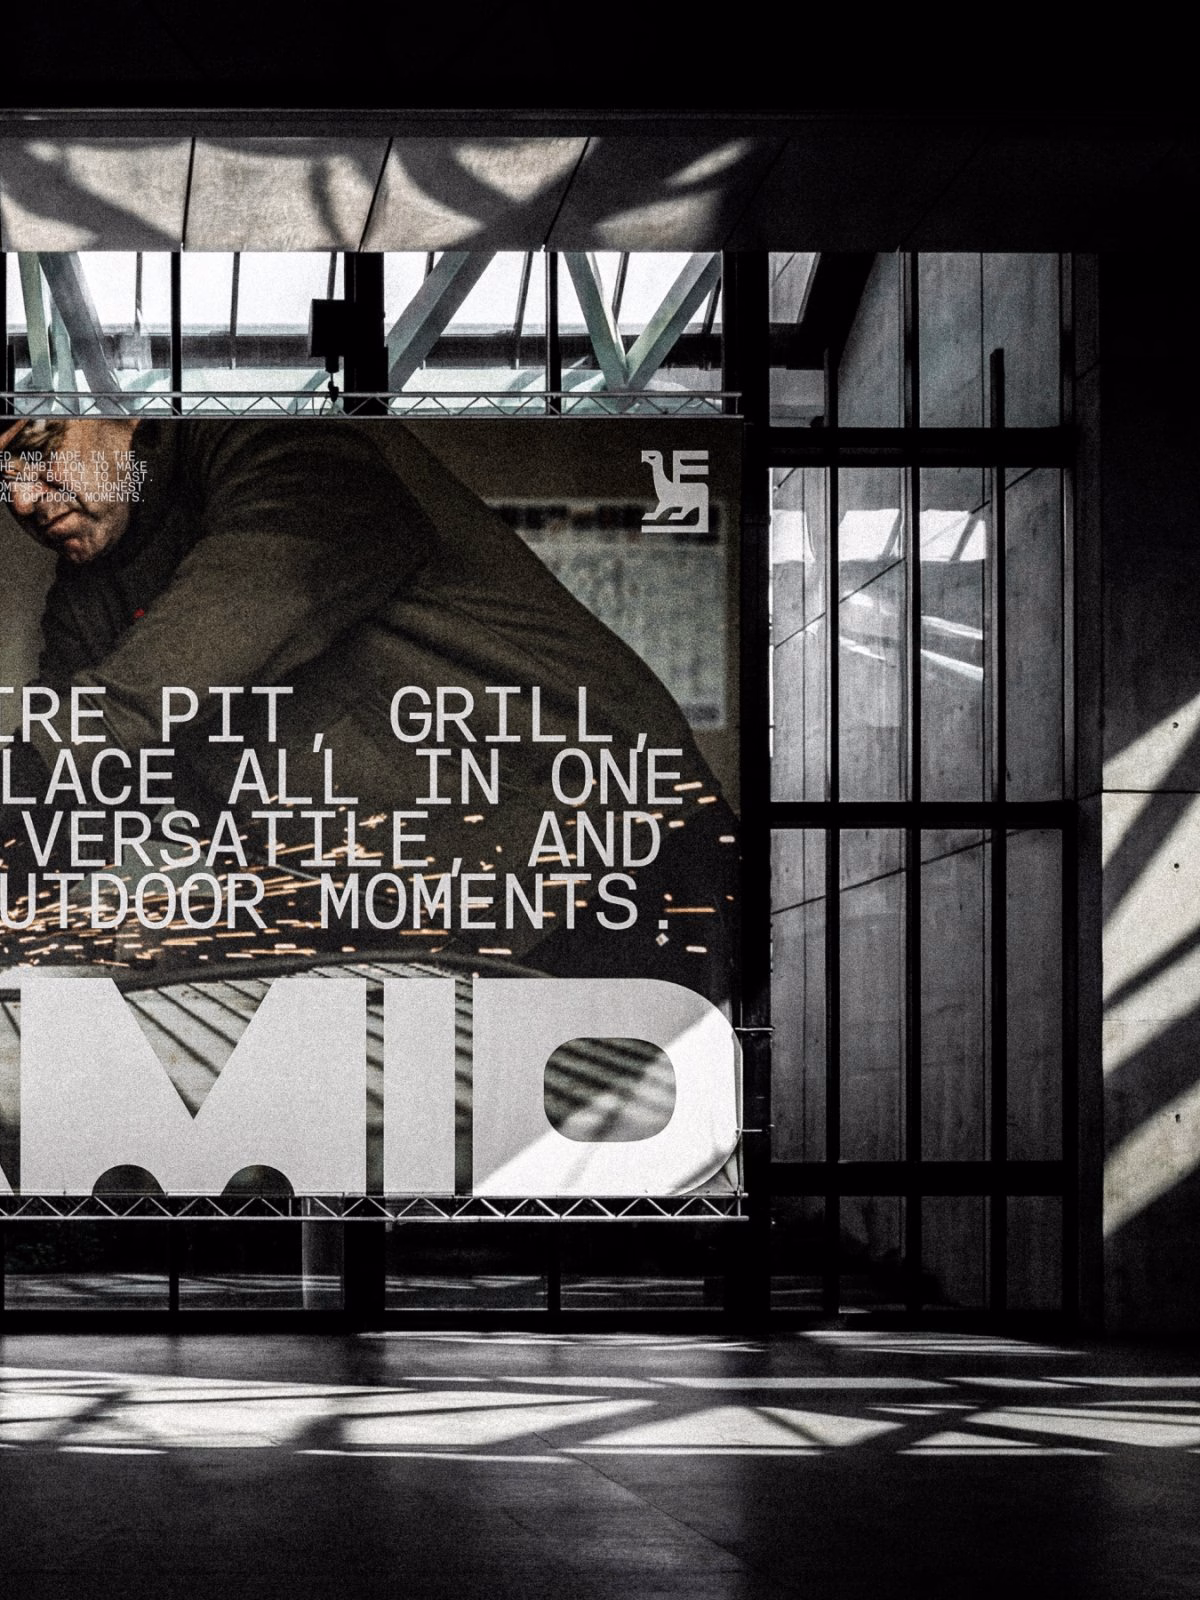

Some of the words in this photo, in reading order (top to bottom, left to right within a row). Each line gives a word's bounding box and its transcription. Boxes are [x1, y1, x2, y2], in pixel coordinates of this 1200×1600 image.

[20, 451, 42, 461] AND
[51, 451, 81, 461] MADE
[91, 451, 104, 461] IN
[114, 451, 135, 461] THE
[23, 462, 85, 472] AMBITION
[94, 462, 108, 472] TO
[117, 462, 147, 472] MAKE
[16, 472, 38, 482] AND
[47, 472, 85, 482] BUILT
[94, 472, 108, 482] TO
[117, 472, 153, 482] LAST.
[59, 482, 89, 492] JUST
[98, 482, 143, 492] HONEST
[23, 492, 77, 502] OUTDOOR
[86, 492, 145, 502] MOMENTS.
[163, 686, 324, 753] PIT,
[390, 686, 648, 753] GRILL,
[228, 749, 359, 805] ALL
[415, 749, 498, 805] IN
[552, 748, 683, 805] ONE
[22, 810, 463, 877] VERSATILE,
[528, 811, 661, 867] AND
[322, 873, 669, 930] MOMENTS.
